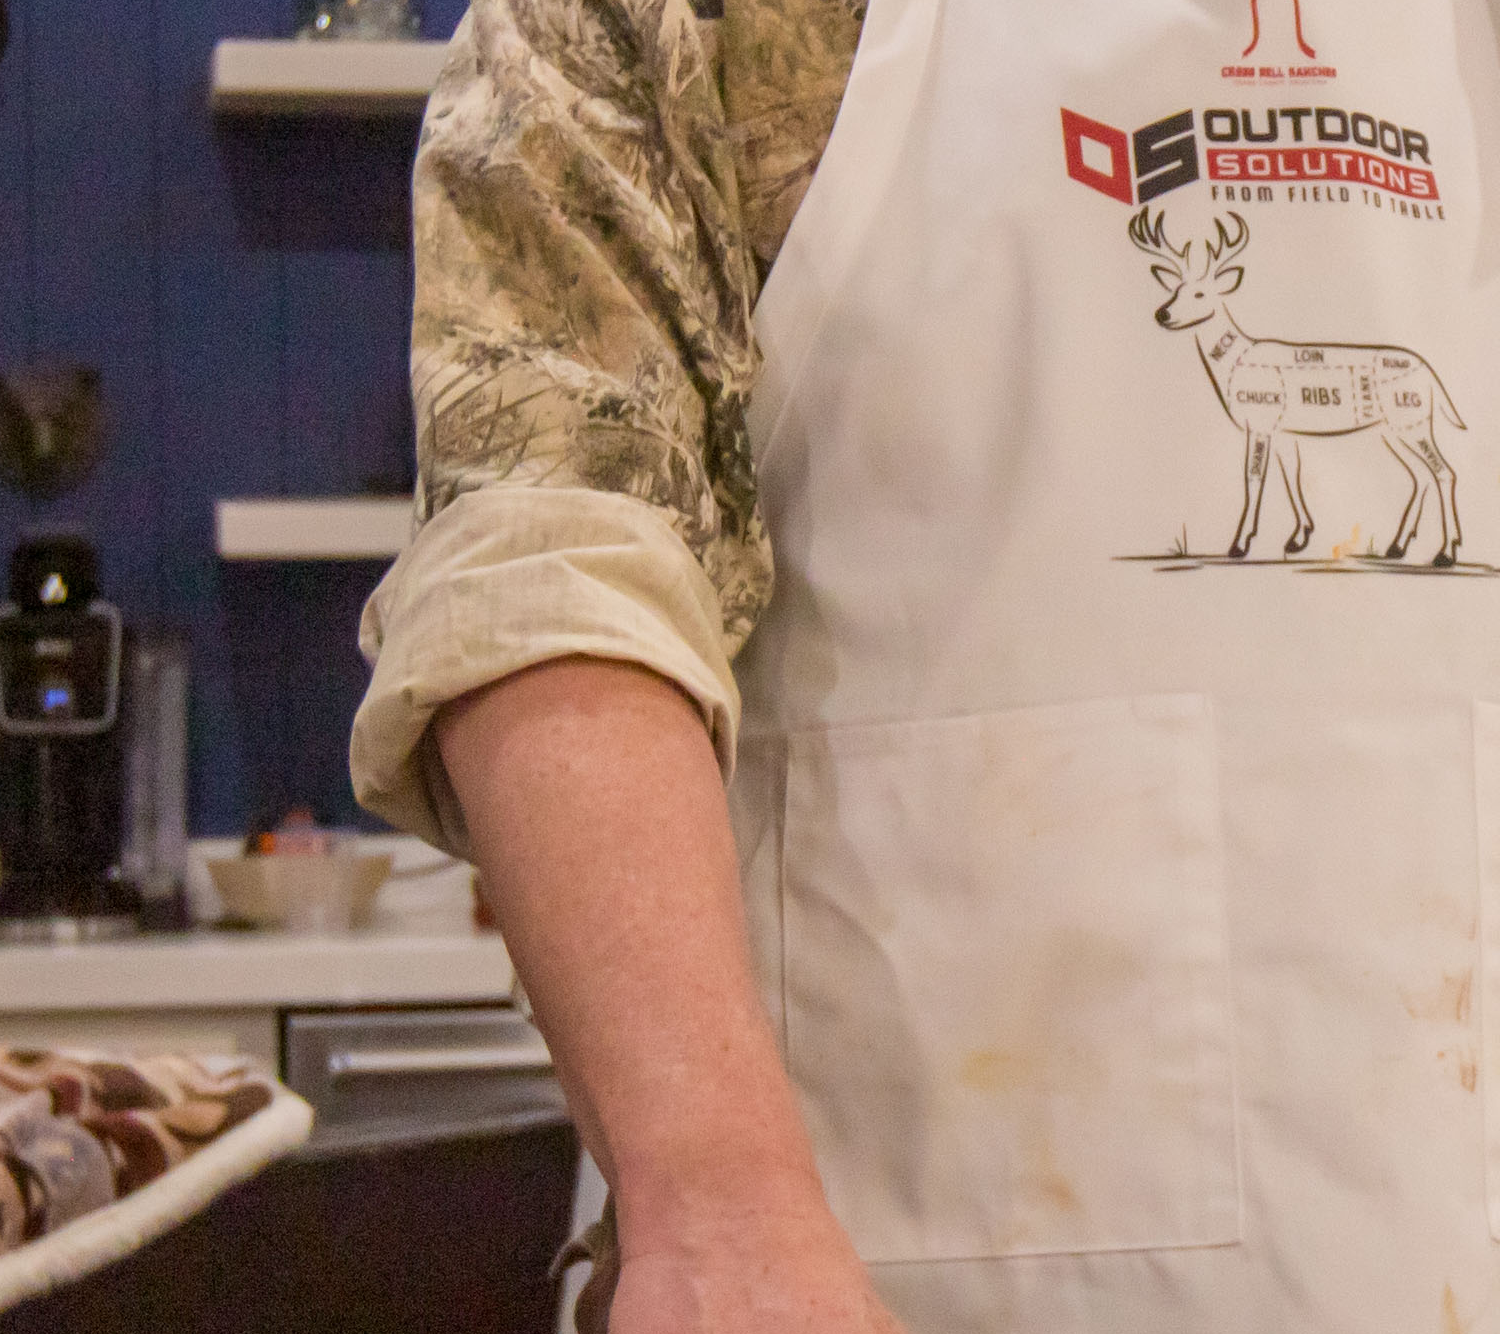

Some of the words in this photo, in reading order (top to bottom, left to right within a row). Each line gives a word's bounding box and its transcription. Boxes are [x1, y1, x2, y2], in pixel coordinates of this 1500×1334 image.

[1203, 107, 1432, 165] OUTDOOR
[1060, 106, 1200, 206] OS
[1215, 152, 1431, 196] SOLUTIONS
[1211, 185, 1274, 203] FROM
[1287, 185, 1350, 203] FIELD
[1362, 189, 1382, 209] TO
[1389, 196, 1447, 221] TABLE
[1294, 349, 1325, 364] LOIN
[1235, 390, 1282, 405] CHUCK
[1301, 386, 1342, 406] RIBS
[1394, 391, 1422, 408] LEG
